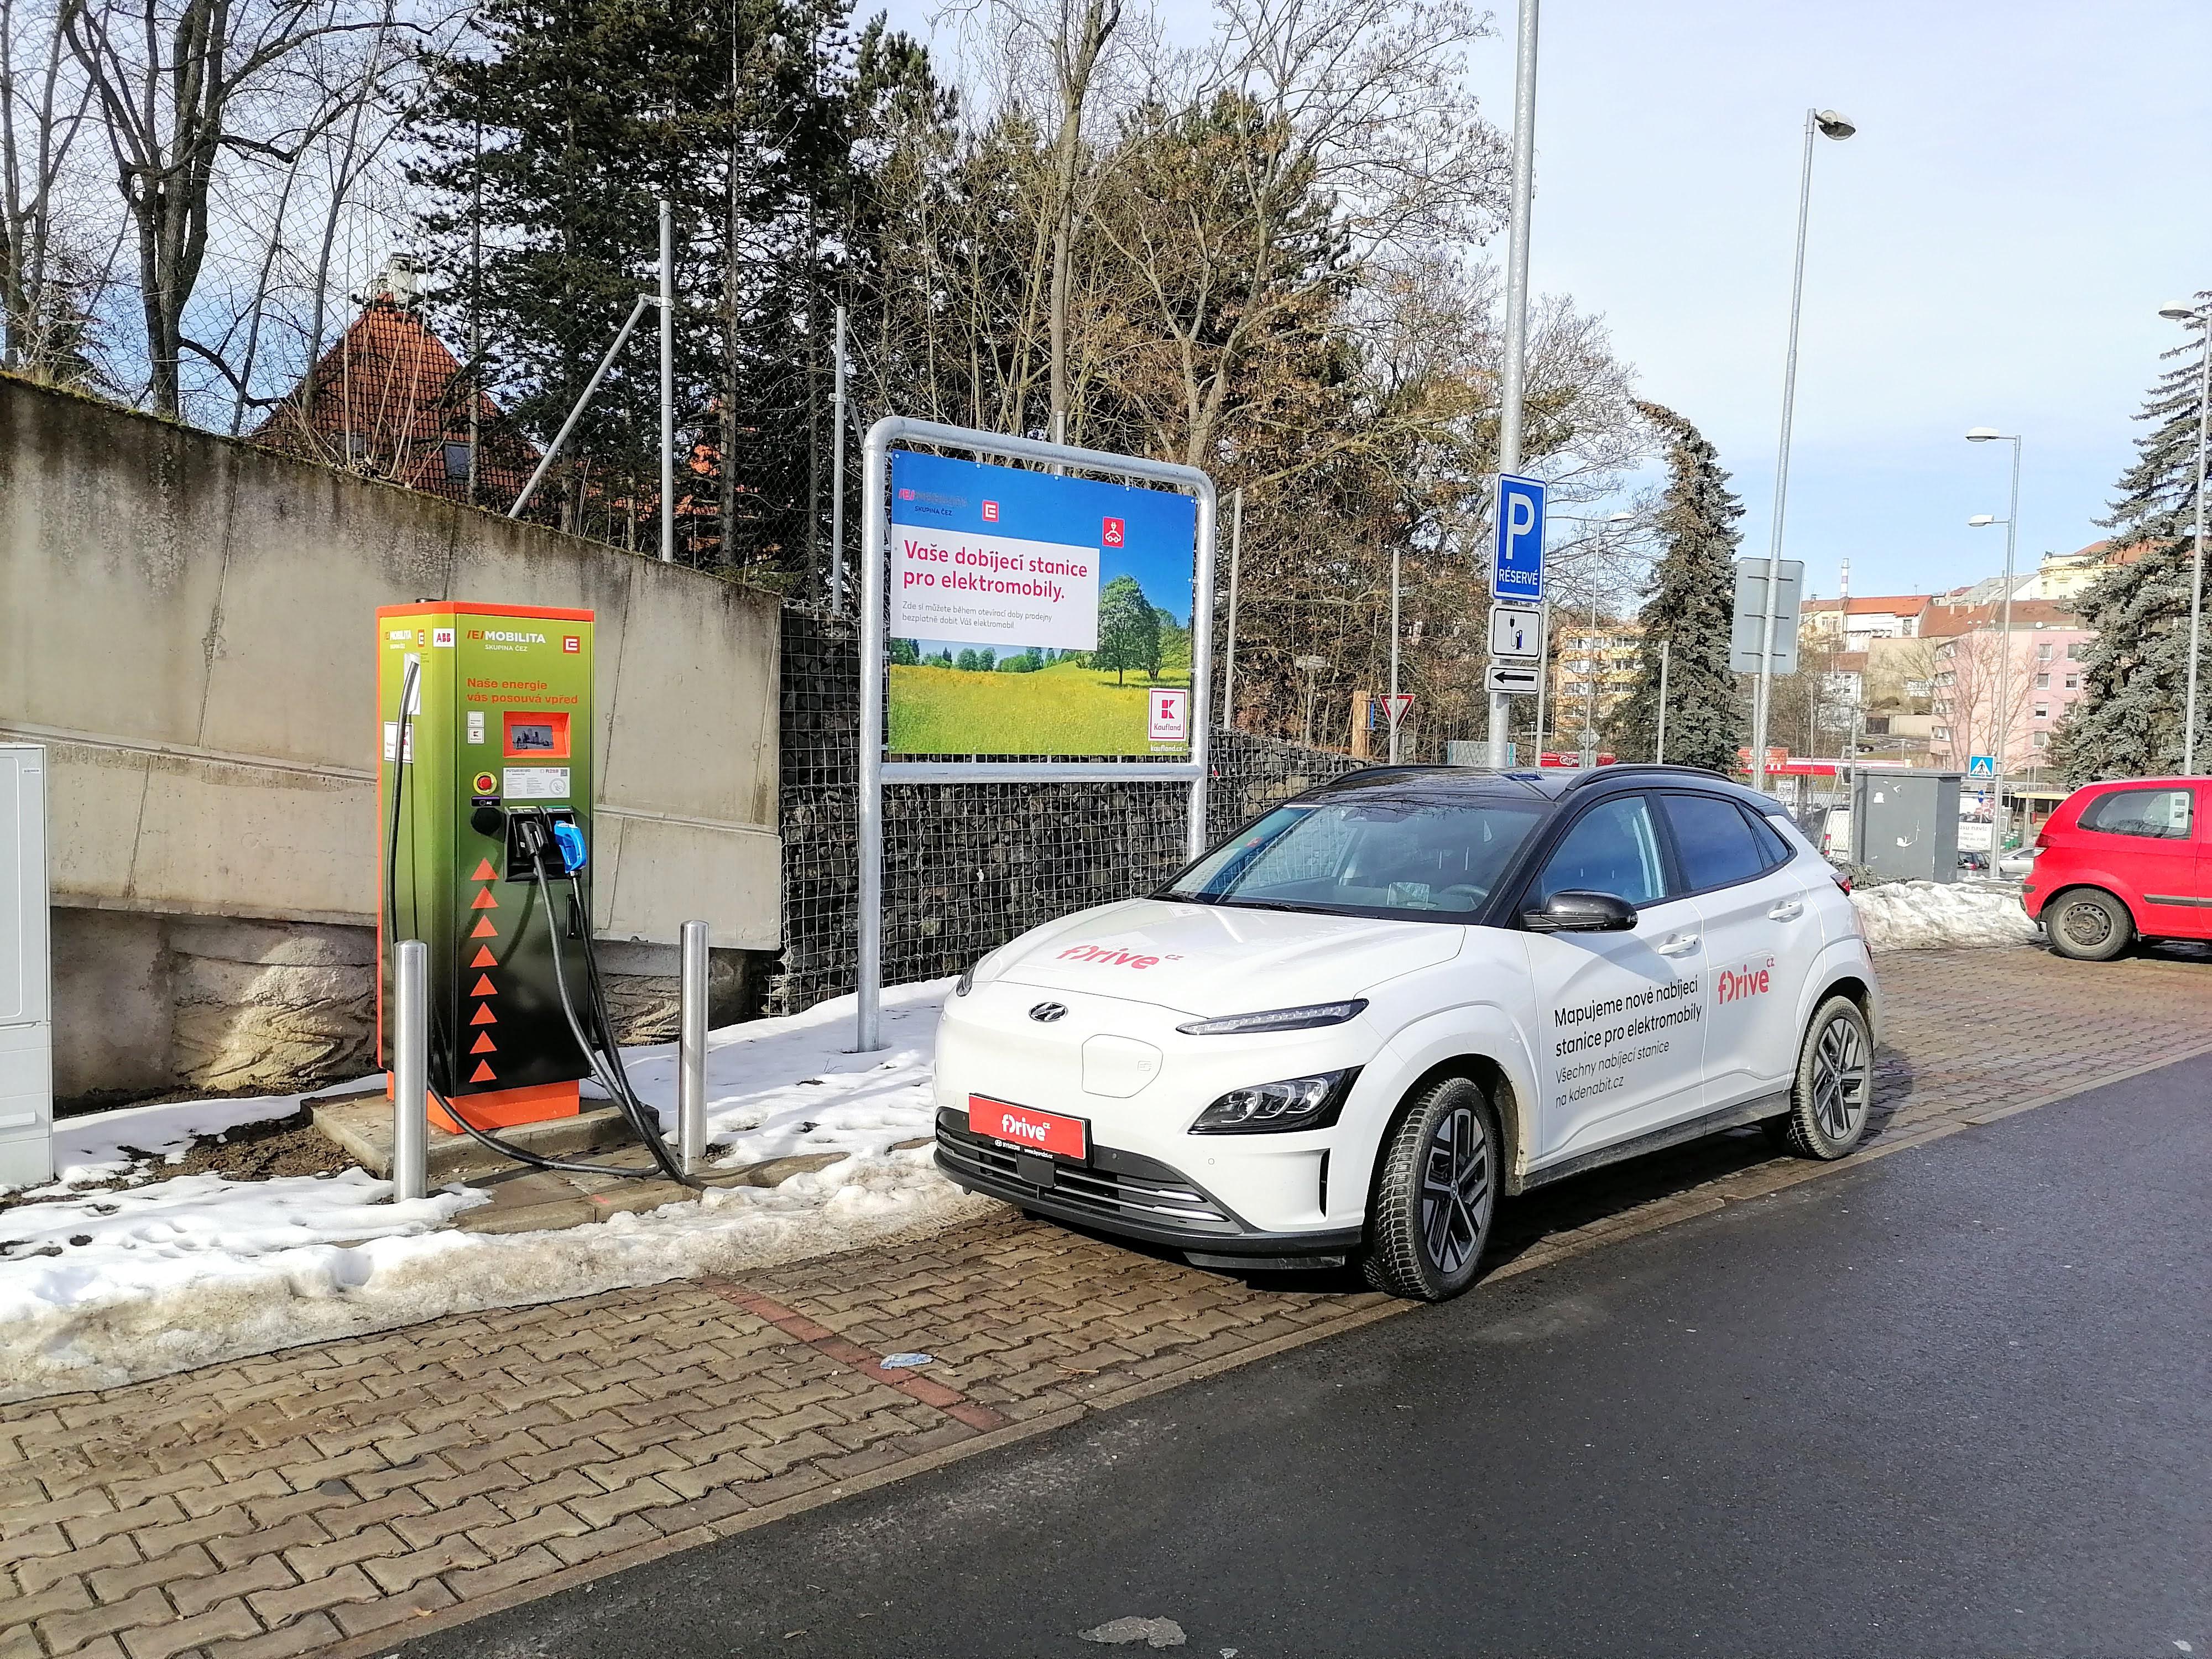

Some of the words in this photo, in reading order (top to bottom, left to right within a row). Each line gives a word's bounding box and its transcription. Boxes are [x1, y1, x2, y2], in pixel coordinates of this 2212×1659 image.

[914, 505, 940, 514] SKUPINA
[941, 508, 953, 516] ČEZ
[1505, 492, 1535, 560] P
[904, 539, 948, 563] Vaše
[955, 546, 1024, 573] dobíjecí
[1029, 556, 1087, 577] stanice
[904, 571, 935, 589] pro
[941, 571, 1065, 603] elektromobily.
[1499, 565, 1538, 586] RÉSERVÉ
[902, 601, 917, 610] Zde
[925, 603, 952, 613] můžete
[953, 606, 977, 615] během
[1007, 610, 1024, 620] doby
[1025, 612, 1052, 623] prodejny
[902, 613, 938, 623] bezplatně
[959, 617, 972, 626] Váš
[973, 620, 1014, 629] elektromobil
[436, 633, 451, 642] ABB
[467, 678, 498, 688] Naše
[502, 680, 547, 691] energie
[467, 692, 488, 701] vás
[491, 694, 541, 703] posouvá
[545, 695, 578, 705] vpřed
[1554, 999, 1623, 1027] Mapujeme
[1626, 986, 1653, 1010] nové
[1656, 974, 1698, 1002] nabíjecí
[1556, 1031, 1601, 1057] stanice
[1605, 1026, 1624, 1047] pro
[1627, 1003, 1702, 1037] elektromobily
[1556, 1062, 1597, 1084] Všechny
[1598, 1047, 1636, 1071] nabíjecí
[1637, 1040, 1670, 1060] stanice
[1556, 1094, 1567, 1109] na
[1569, 1076, 1624, 1103] kdenabit.cz
